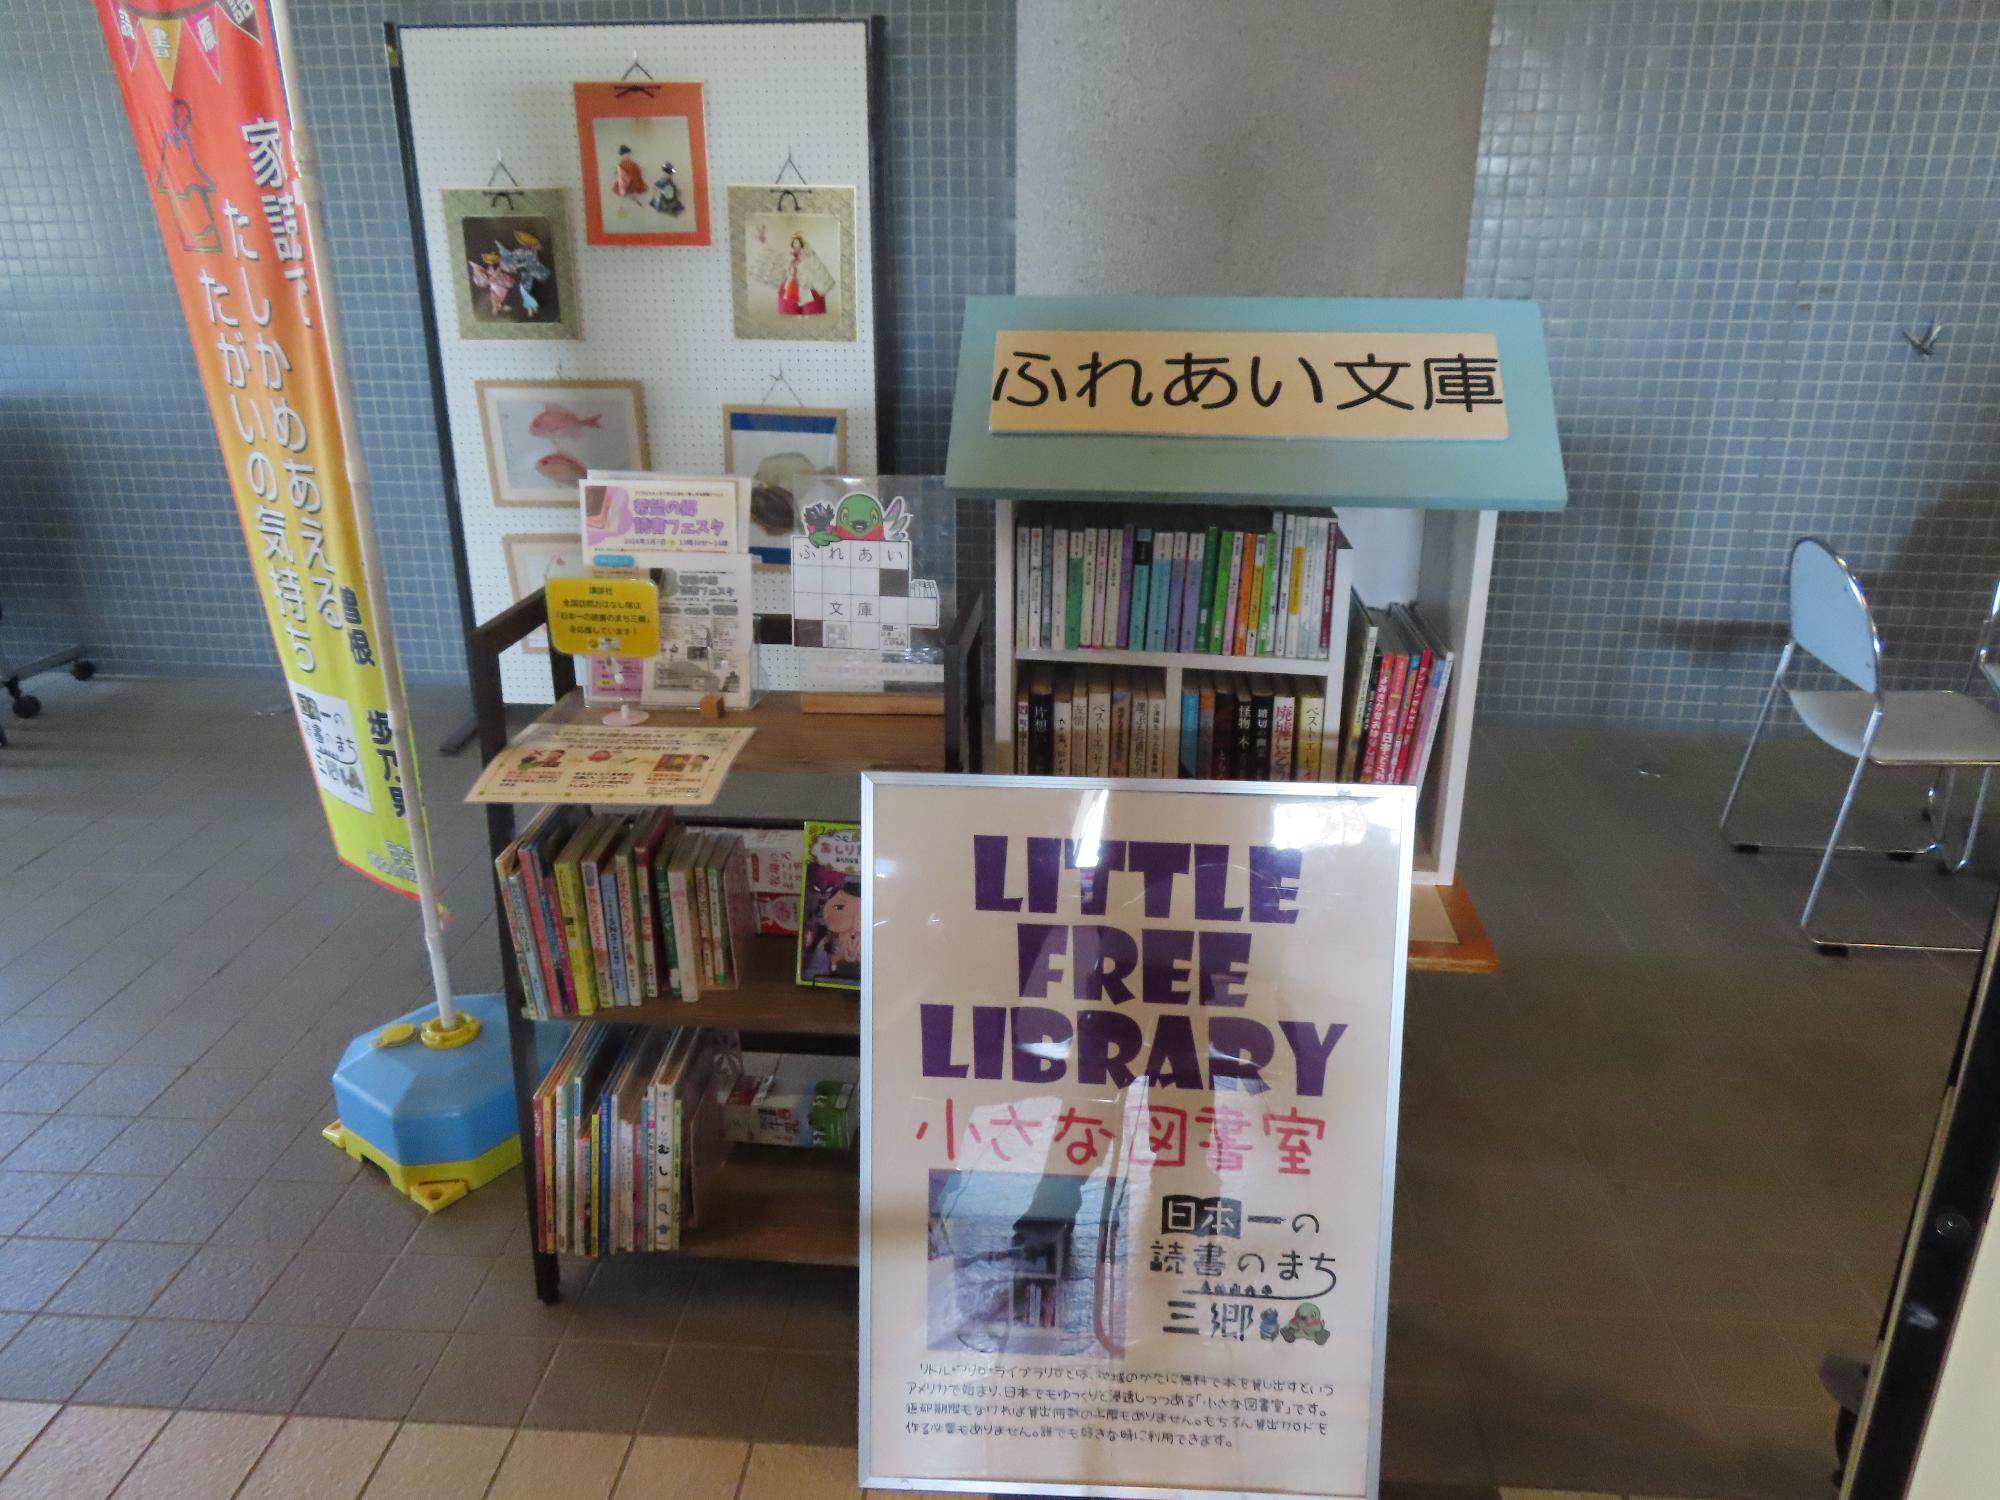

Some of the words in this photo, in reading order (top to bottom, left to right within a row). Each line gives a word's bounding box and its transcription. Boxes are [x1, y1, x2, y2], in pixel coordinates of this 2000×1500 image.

[223, 199, 343, 630] たしかめあえる
[993, 352, 1503, 413] ふれあい文庫
[200, 269, 315, 673] たがいの気持ち
[800, 546, 903, 562] ふれあい
[829, 601, 873, 616] 文庫
[974, 834, 1304, 924] LITTLE
[1017, 923, 1252, 1007] FREE
[920, 1003, 1348, 1097] LIBRARY
[916, 1098, 1325, 1176] 小さな図書室
[1165, 1197, 1320, 1237] 日本一の
[1150, 1240, 1337, 1291] 読書のまち
[1162, 1301, 1254, 1342] 三郷
